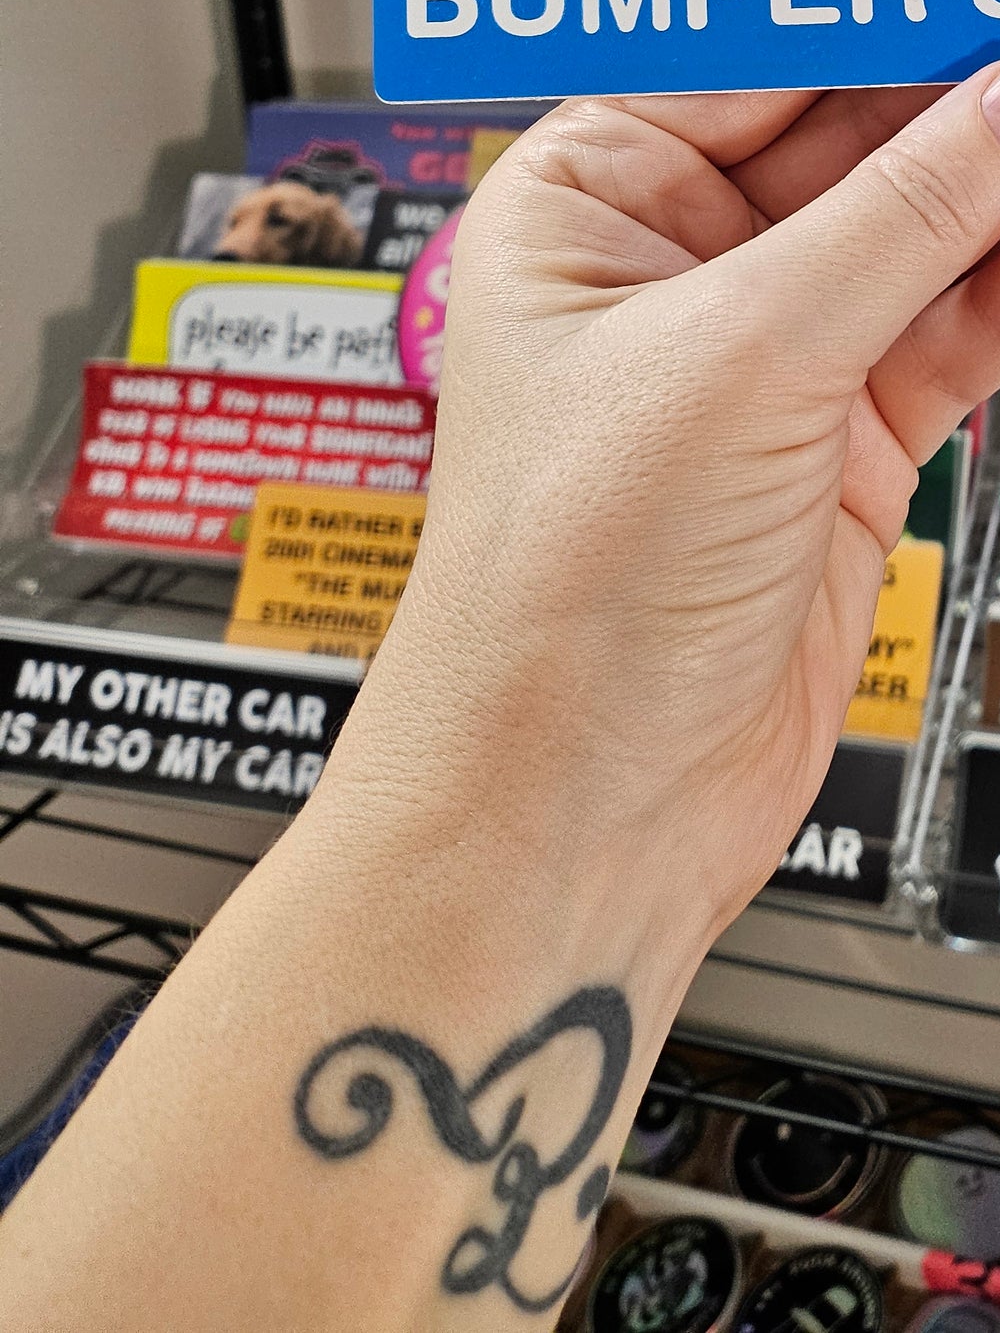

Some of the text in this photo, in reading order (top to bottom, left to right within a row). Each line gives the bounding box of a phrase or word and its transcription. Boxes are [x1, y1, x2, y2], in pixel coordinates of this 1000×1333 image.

[181, 302, 279, 360] please
[286, 311, 326, 359] be
[307, 507, 405, 537] RATHER
[261, 600, 383, 632] STARRING
[15, 658, 328, 742] MY OTHER CAR
[0, 710, 325, 799] IS ALSO MY CAR
